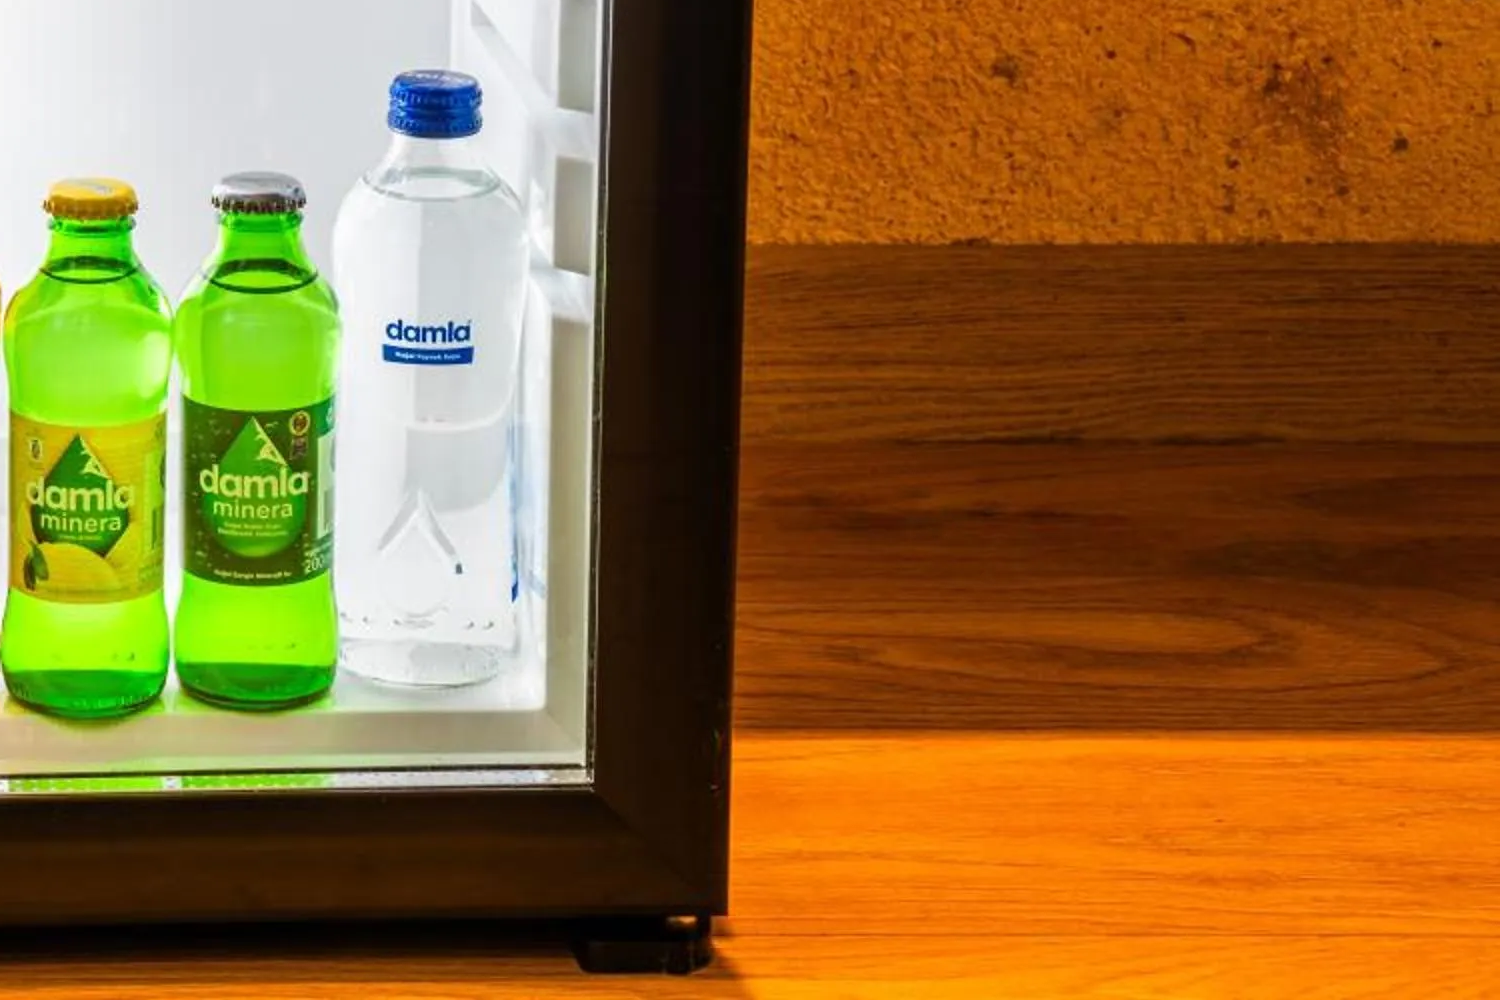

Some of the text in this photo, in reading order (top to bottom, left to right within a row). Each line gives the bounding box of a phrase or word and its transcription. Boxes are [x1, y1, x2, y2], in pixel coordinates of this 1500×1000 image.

[386, 319, 471, 342] damla
[200, 464, 310, 499] damla
[26, 477, 135, 510] damla
[213, 499, 293, 519] minera
[40, 512, 121, 532] minera
